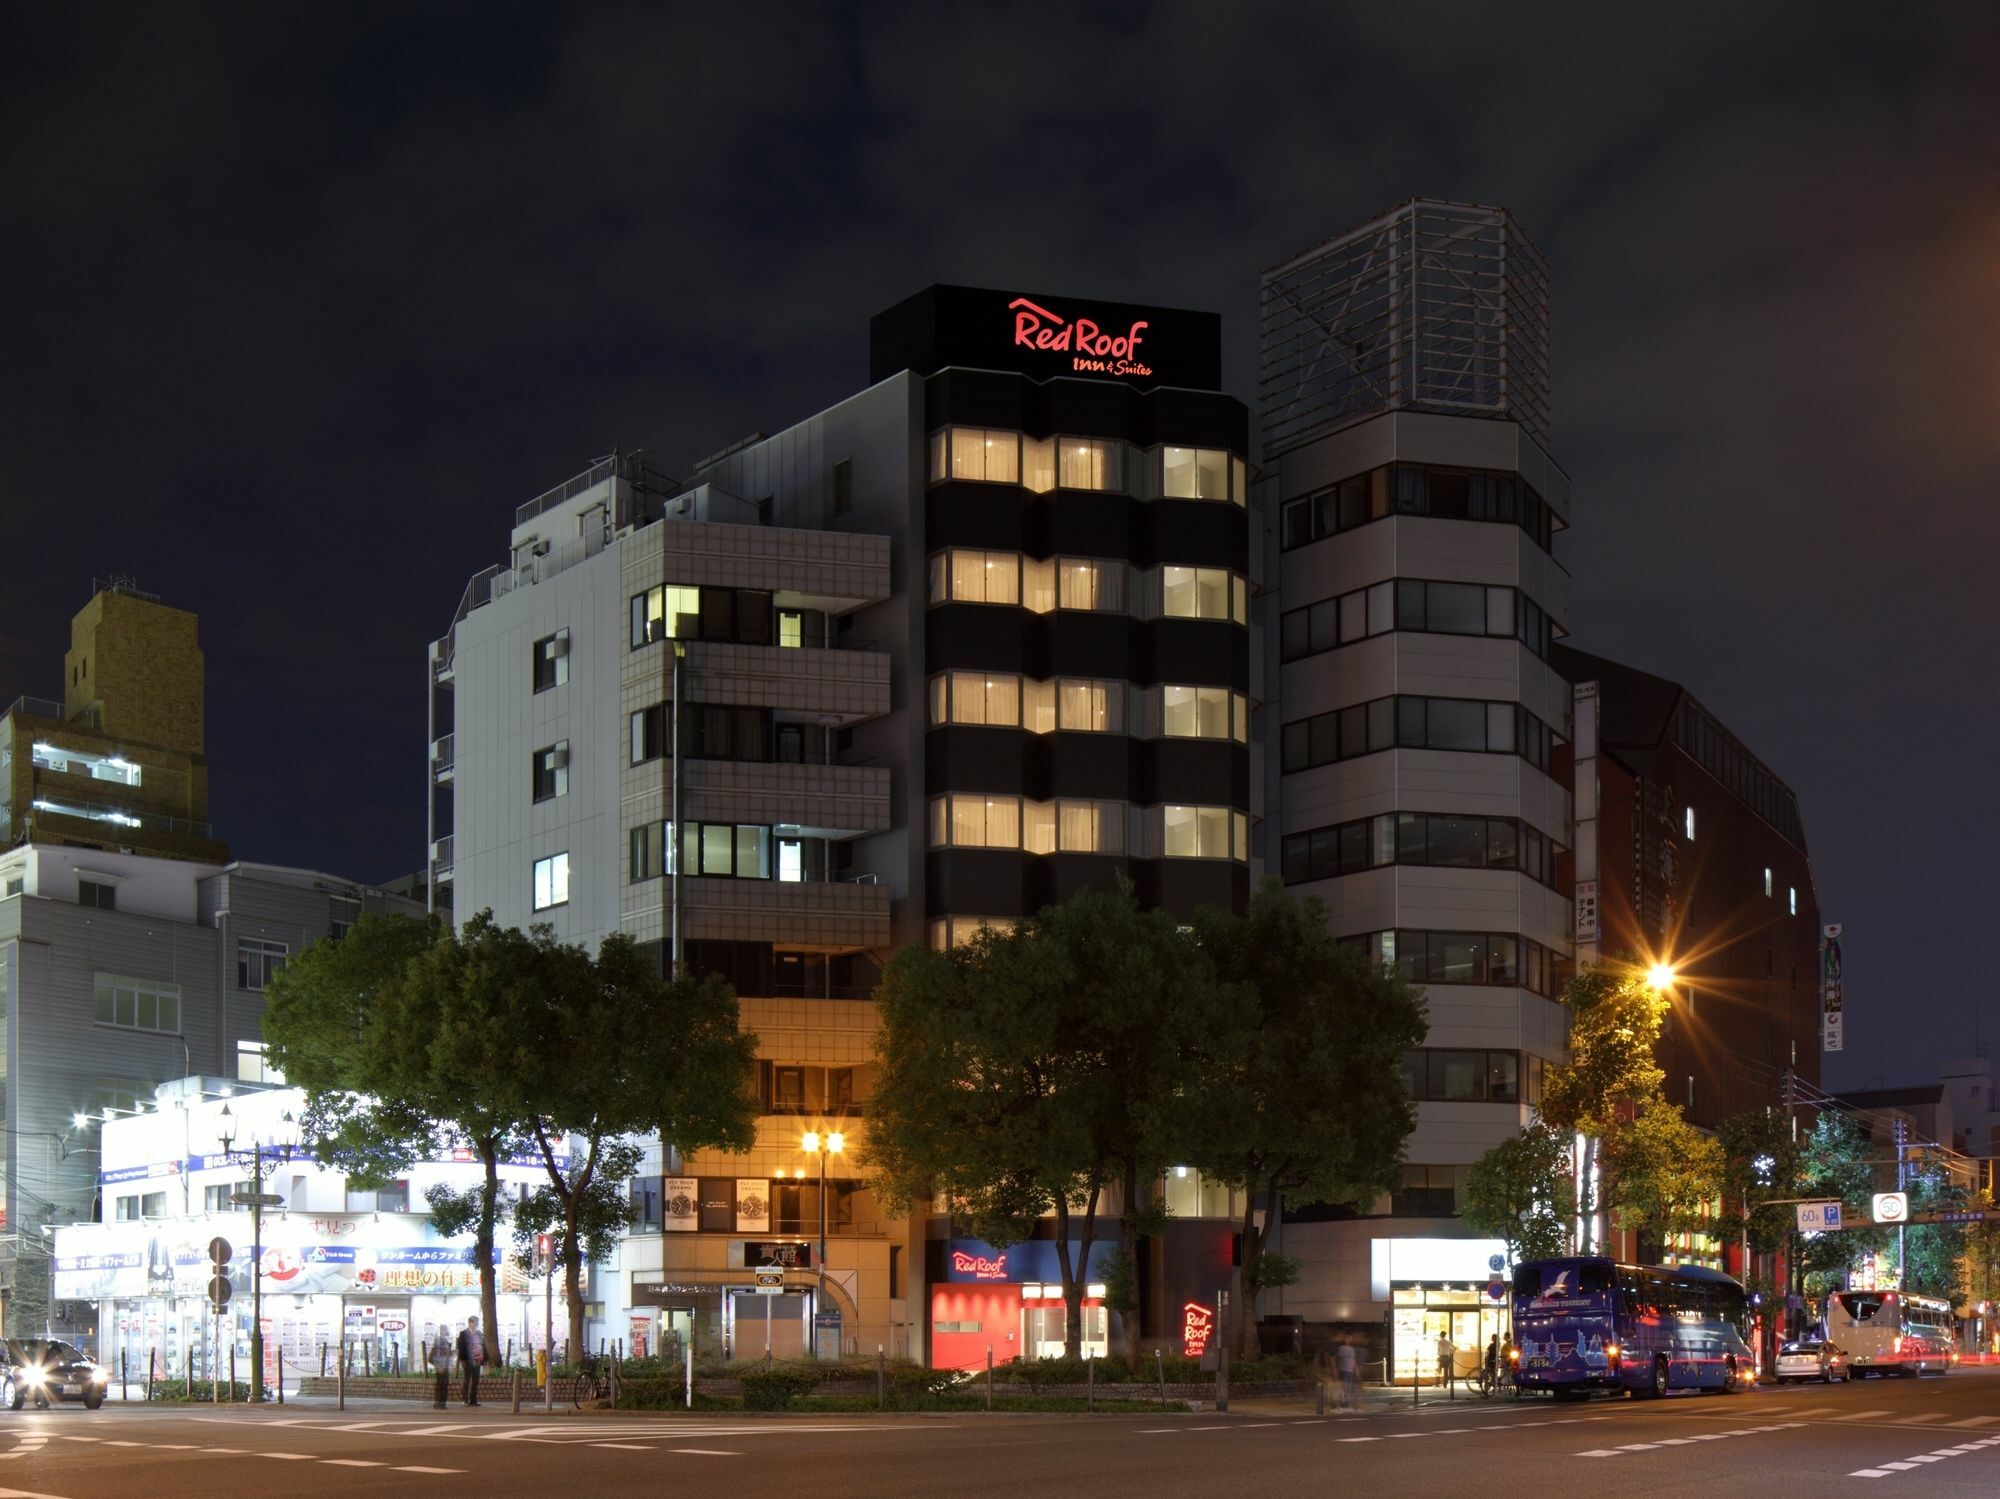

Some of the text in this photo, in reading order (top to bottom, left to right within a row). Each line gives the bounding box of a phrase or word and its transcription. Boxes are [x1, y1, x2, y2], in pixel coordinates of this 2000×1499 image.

[1015, 311, 1148, 360] Red Roof
[1073, 357, 1106, 372] Inn
[1114, 359, 1153, 376] Suites
[1827, 1207, 1836, 1219] P
[1882, 1201, 1898, 1213] 50
[955, 1255, 1006, 1273] Red Roof
[384, 1268, 483, 1288] 理想の住ま
[1186, 1311, 1206, 1327] Red
[1184, 1324, 1212, 1342] Roof
